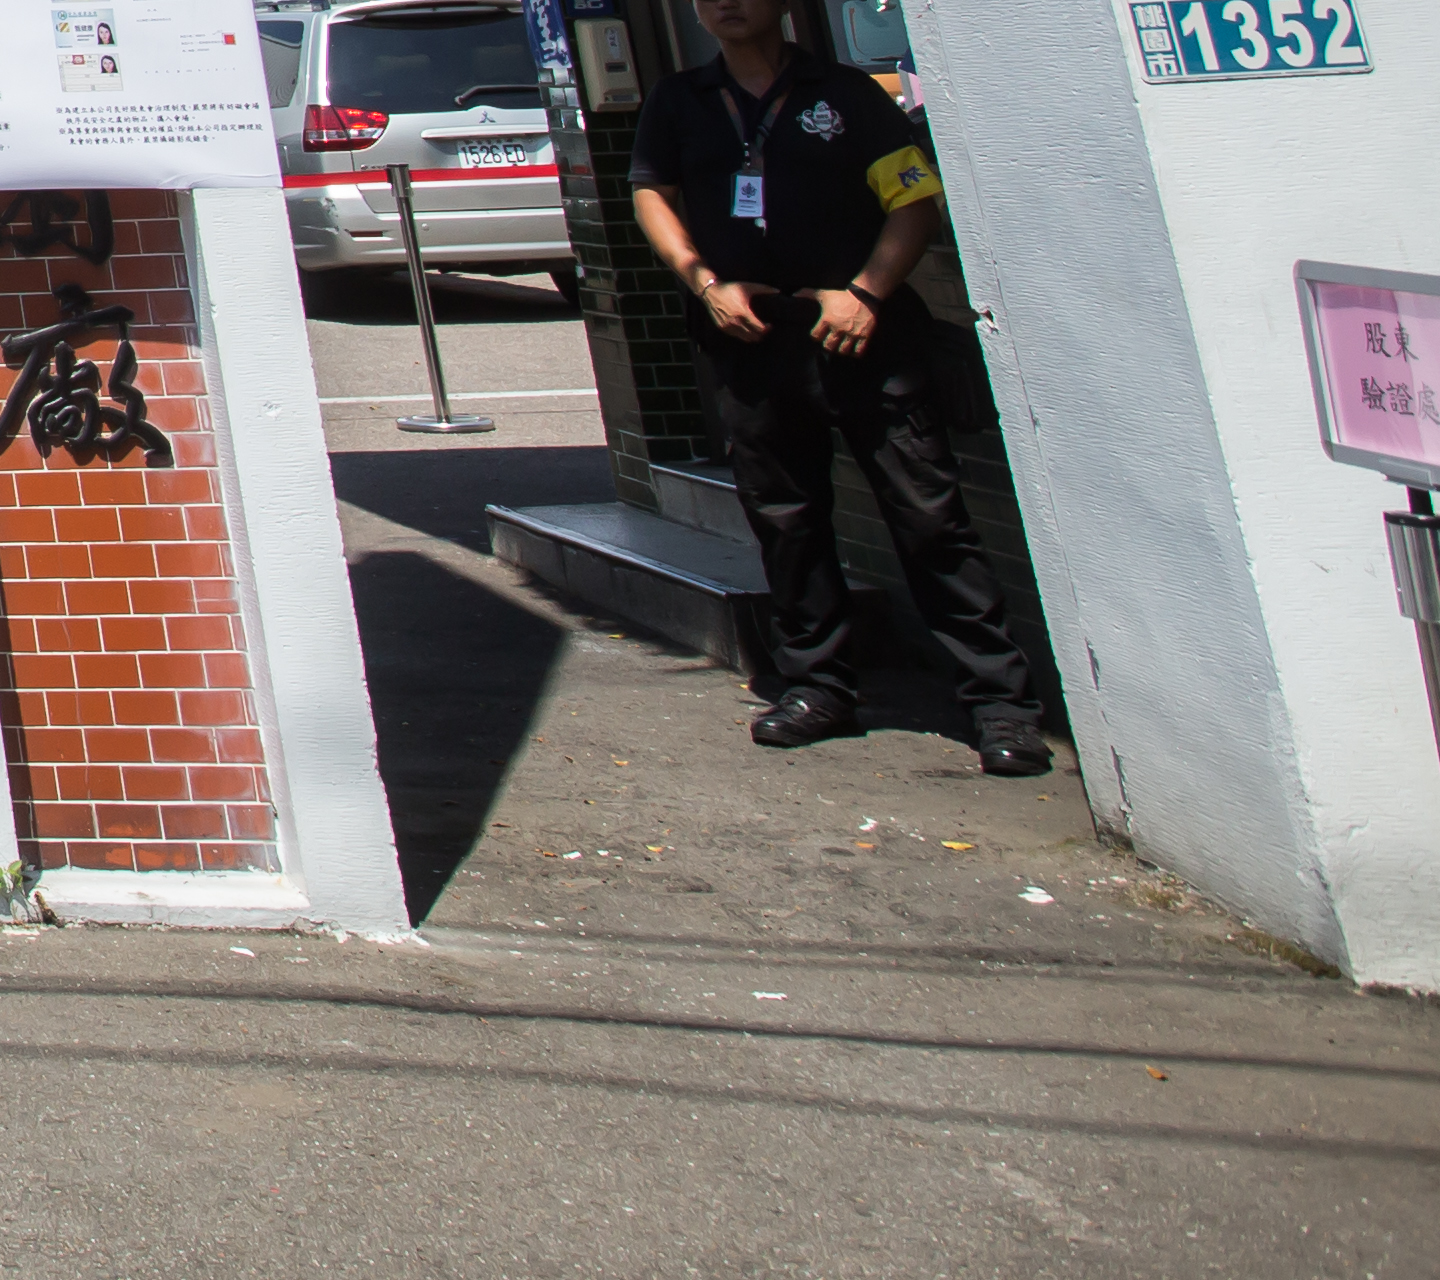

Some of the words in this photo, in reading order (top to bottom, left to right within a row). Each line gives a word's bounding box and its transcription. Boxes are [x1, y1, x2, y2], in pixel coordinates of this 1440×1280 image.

[1133, 4, 1178, 76] 桃園市
[1364, 320, 1419, 363] 股東
[1360, 376, 1440, 426] 驗證處
